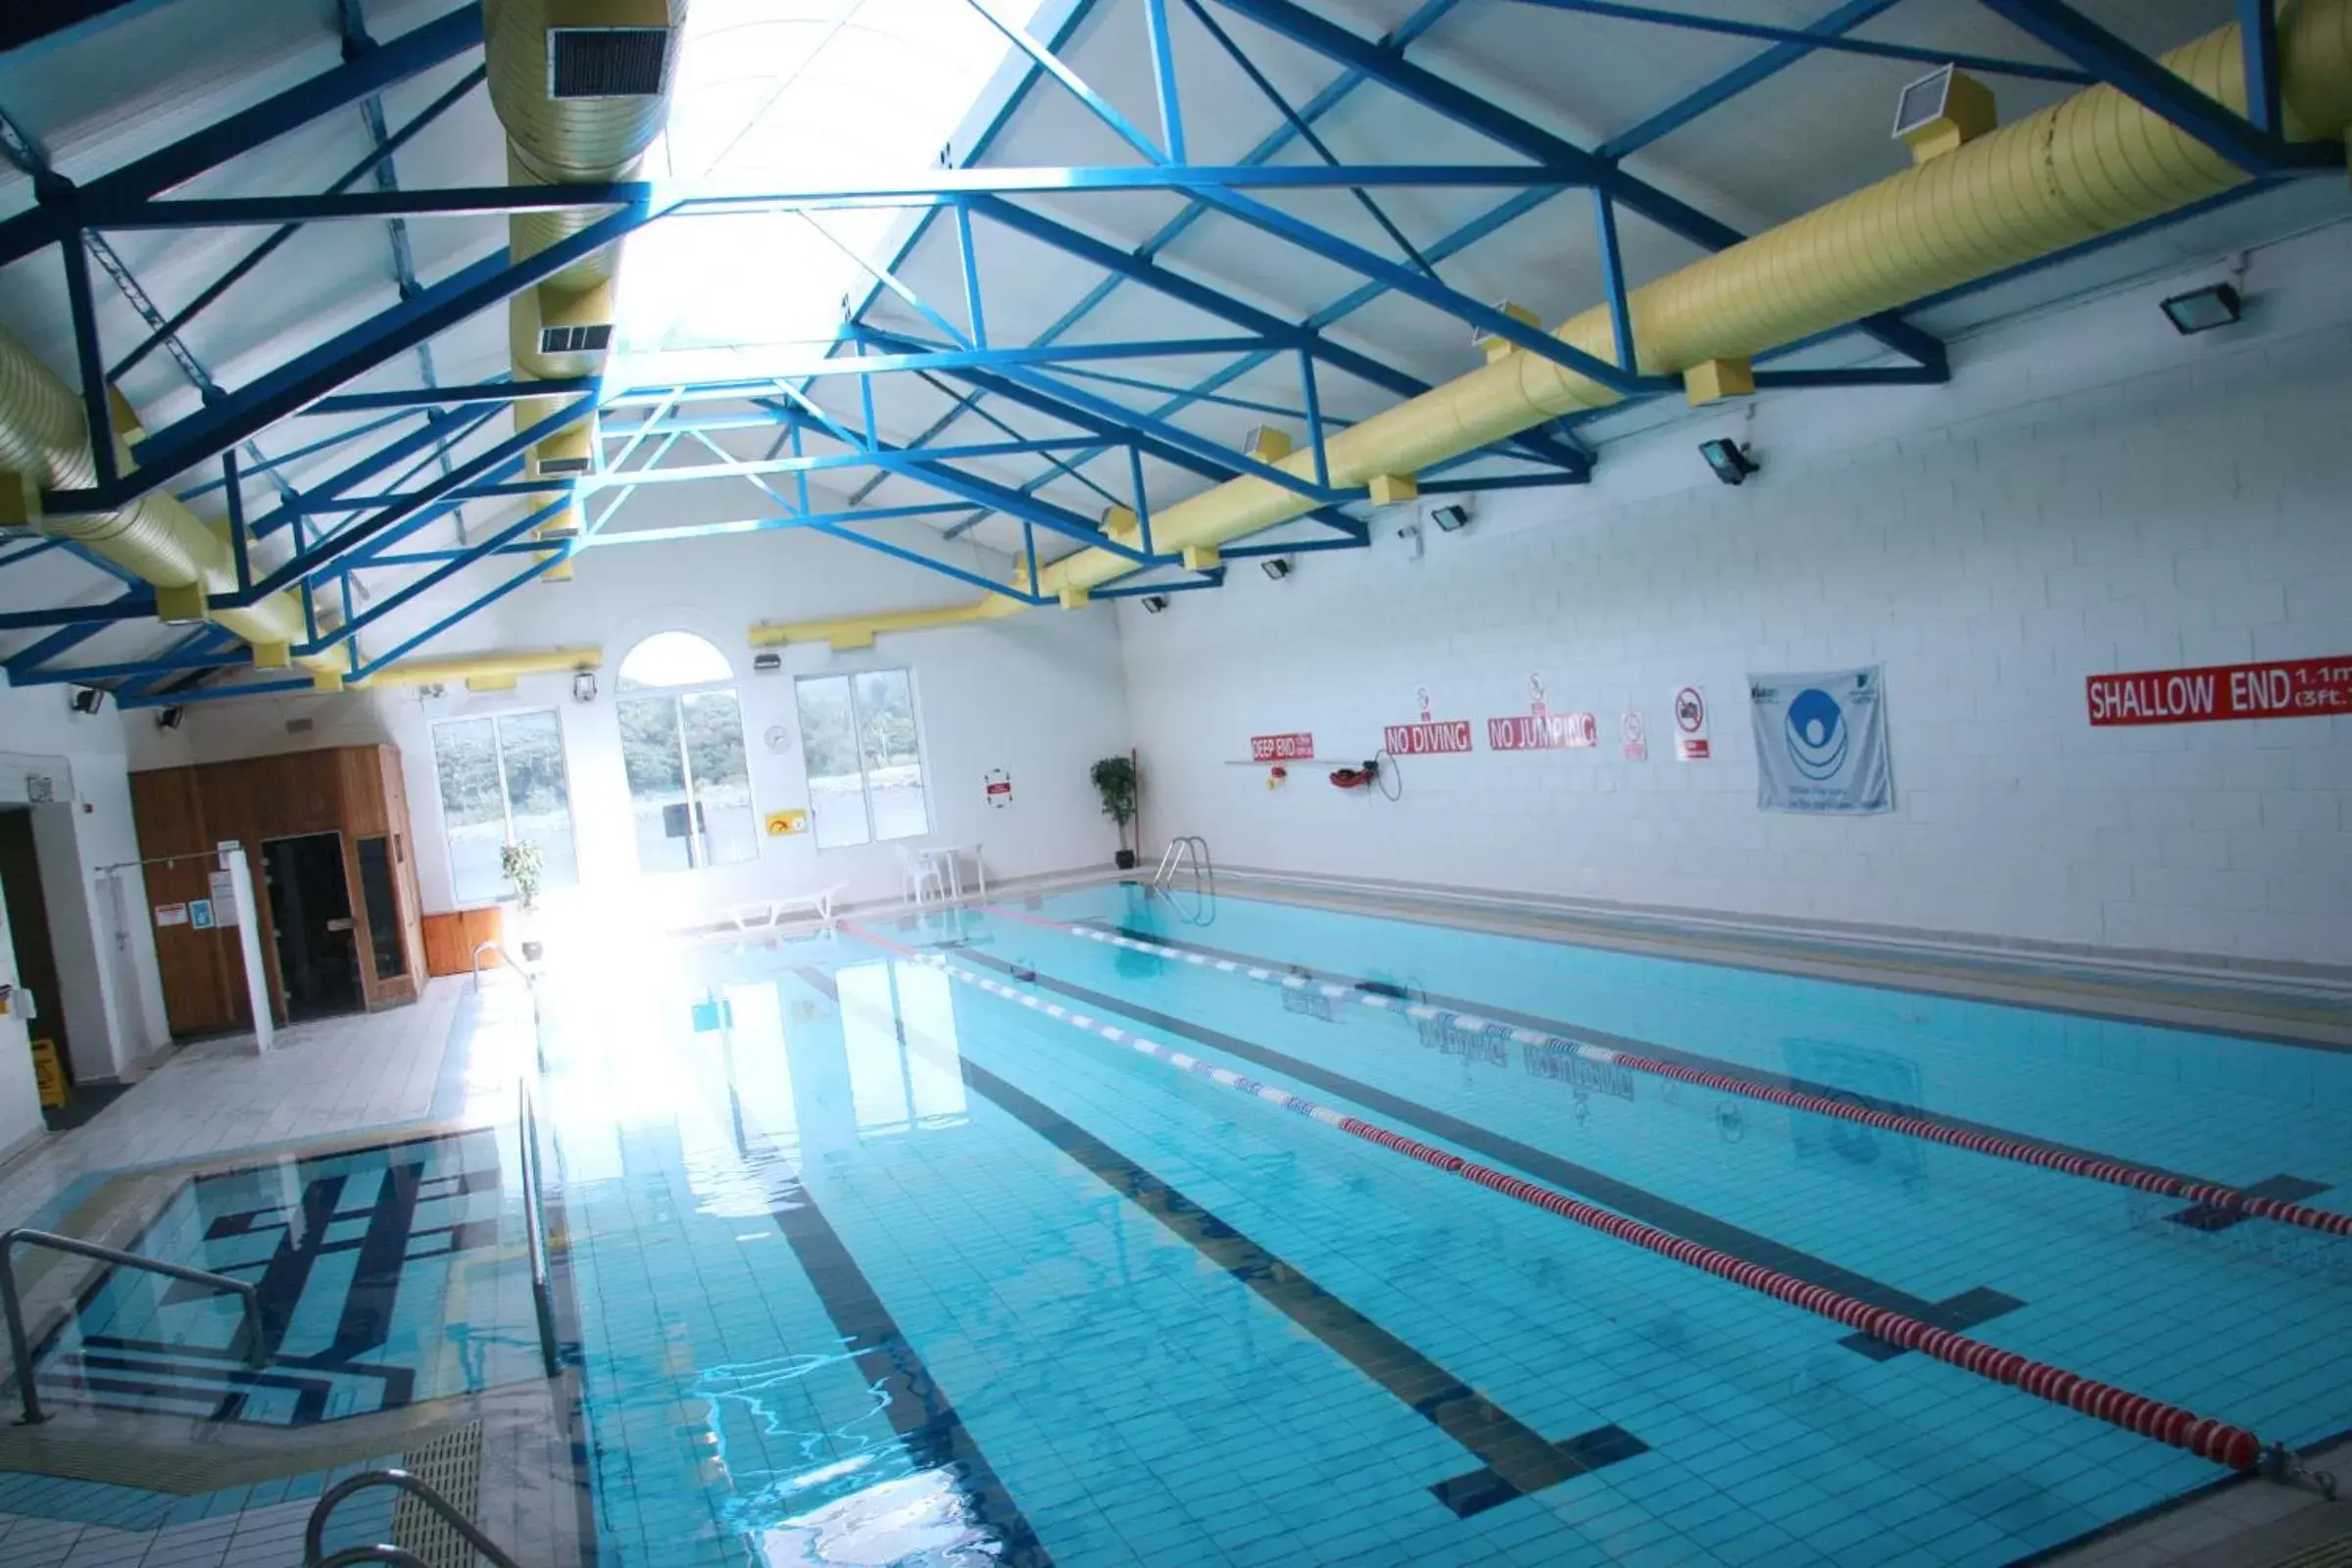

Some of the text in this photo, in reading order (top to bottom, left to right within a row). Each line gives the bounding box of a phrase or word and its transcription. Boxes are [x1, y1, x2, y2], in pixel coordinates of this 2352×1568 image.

[2090, 668, 2290, 719] SHALLOW END
[1277, 737, 1296, 757] END
[1387, 723, 1468, 754] NO DIVING
[1490, 719, 1513, 748] NO
